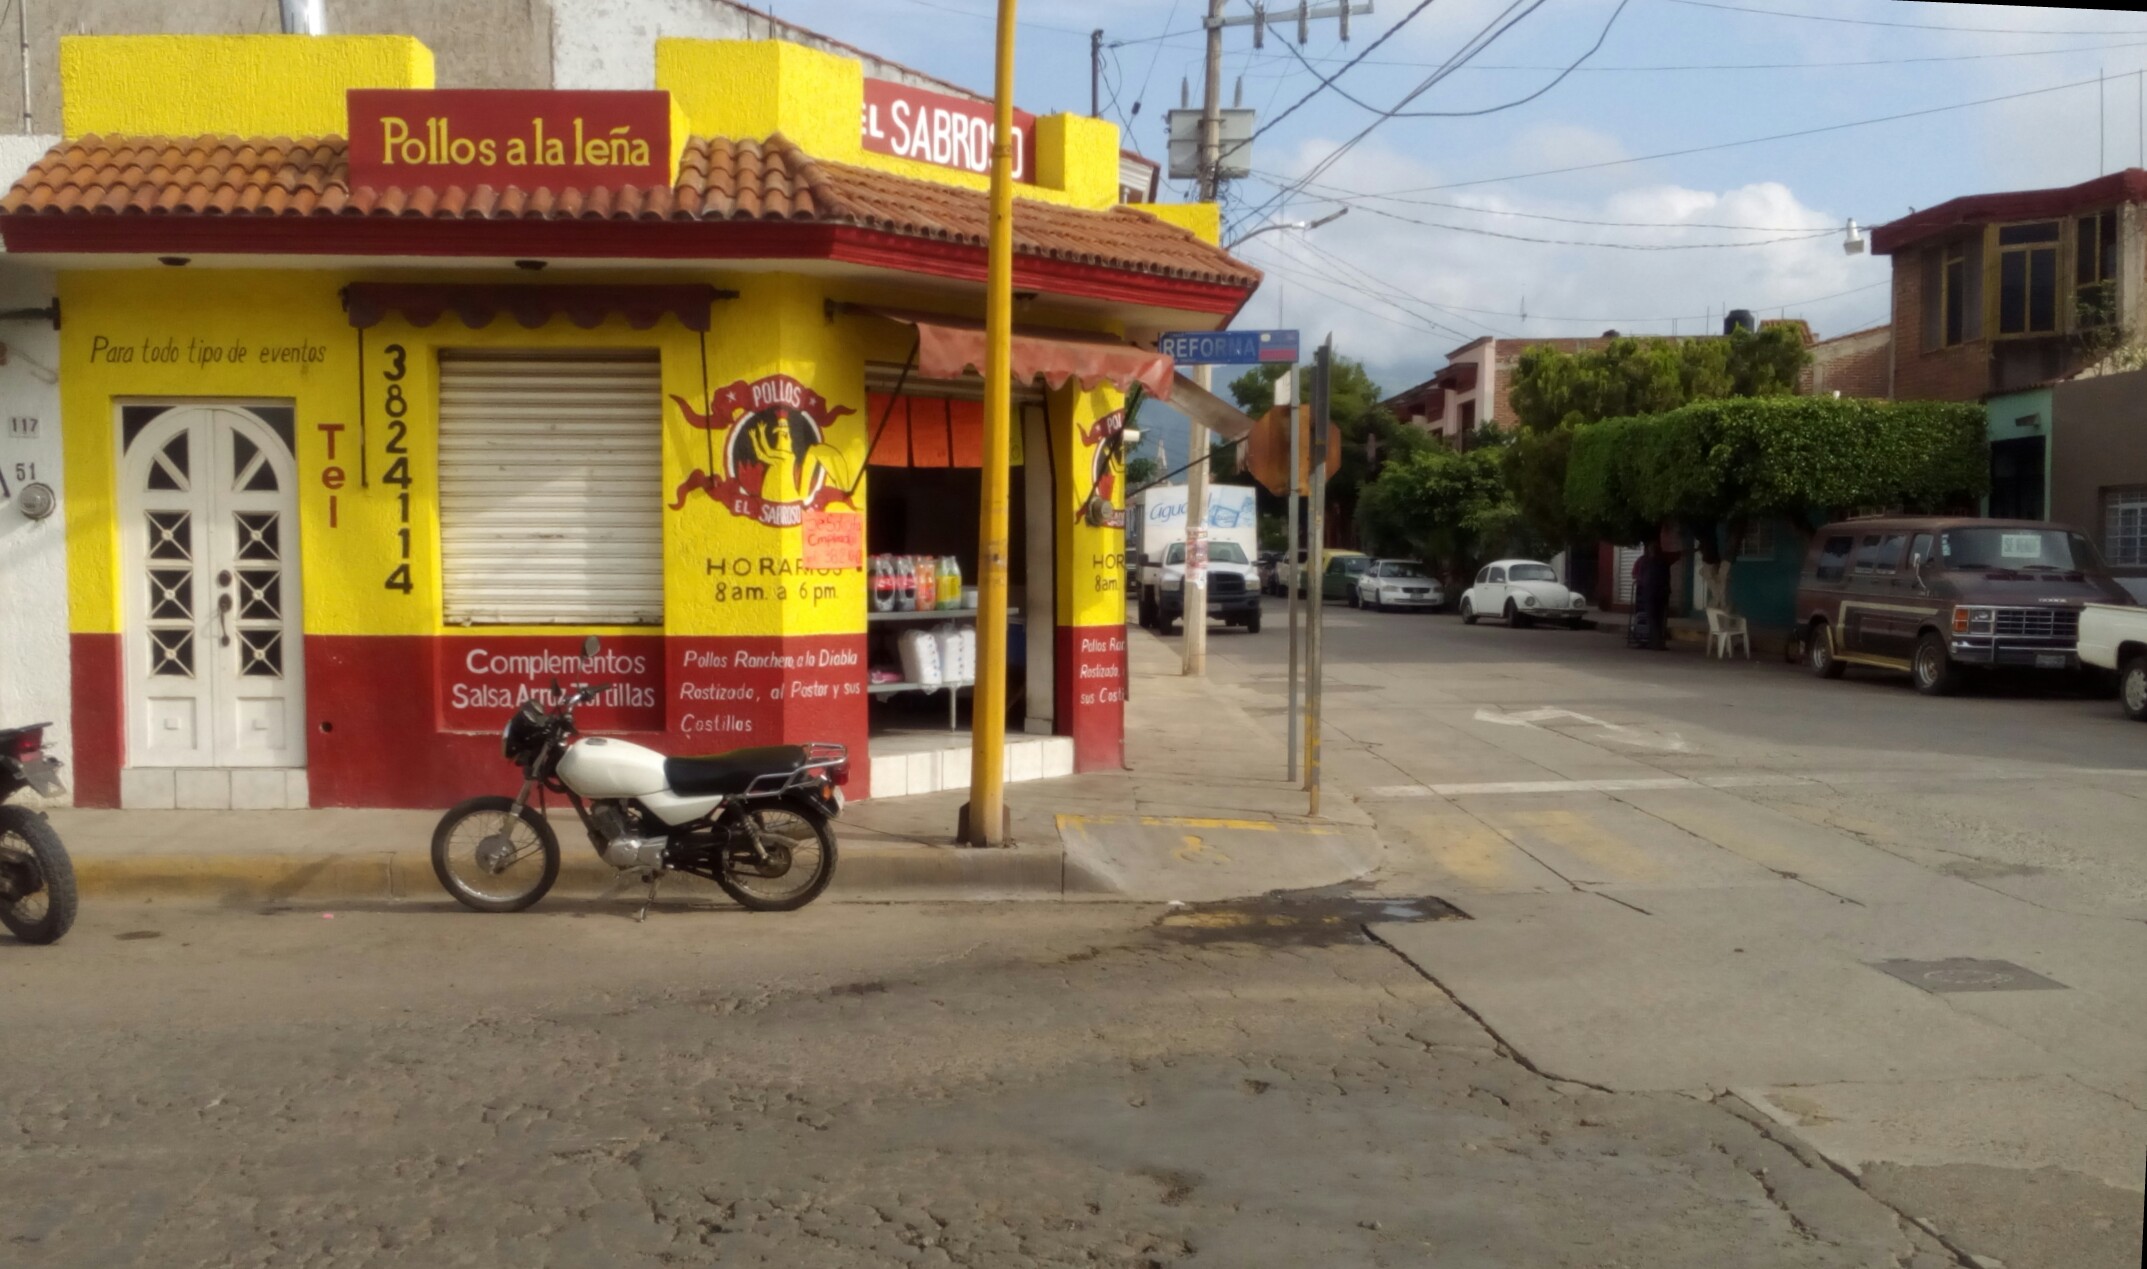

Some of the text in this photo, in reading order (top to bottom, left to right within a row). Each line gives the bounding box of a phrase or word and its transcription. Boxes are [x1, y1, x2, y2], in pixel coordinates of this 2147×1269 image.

[380, 117, 650, 166] Pollos a la leña
[890, 99, 1023, 179] SABROO
[90, 335, 327, 369] Para todo tipo de eventos
[1163, 337, 1256, 358] REFORMA
[752, 379, 801, 408] POLLOS
[12, 417, 39, 433] 117
[15, 462, 36, 481] 51
[734, 499, 751, 515] EL
[466, 649, 646, 681] Complementos
[683, 650, 727, 668] Pollos
[819, 648, 857, 667] Diabla
[770, 684, 785, 700] al
[832, 684, 840, 700] y
[843, 682, 861, 696] sus
[680, 713, 752, 733] Costillas
